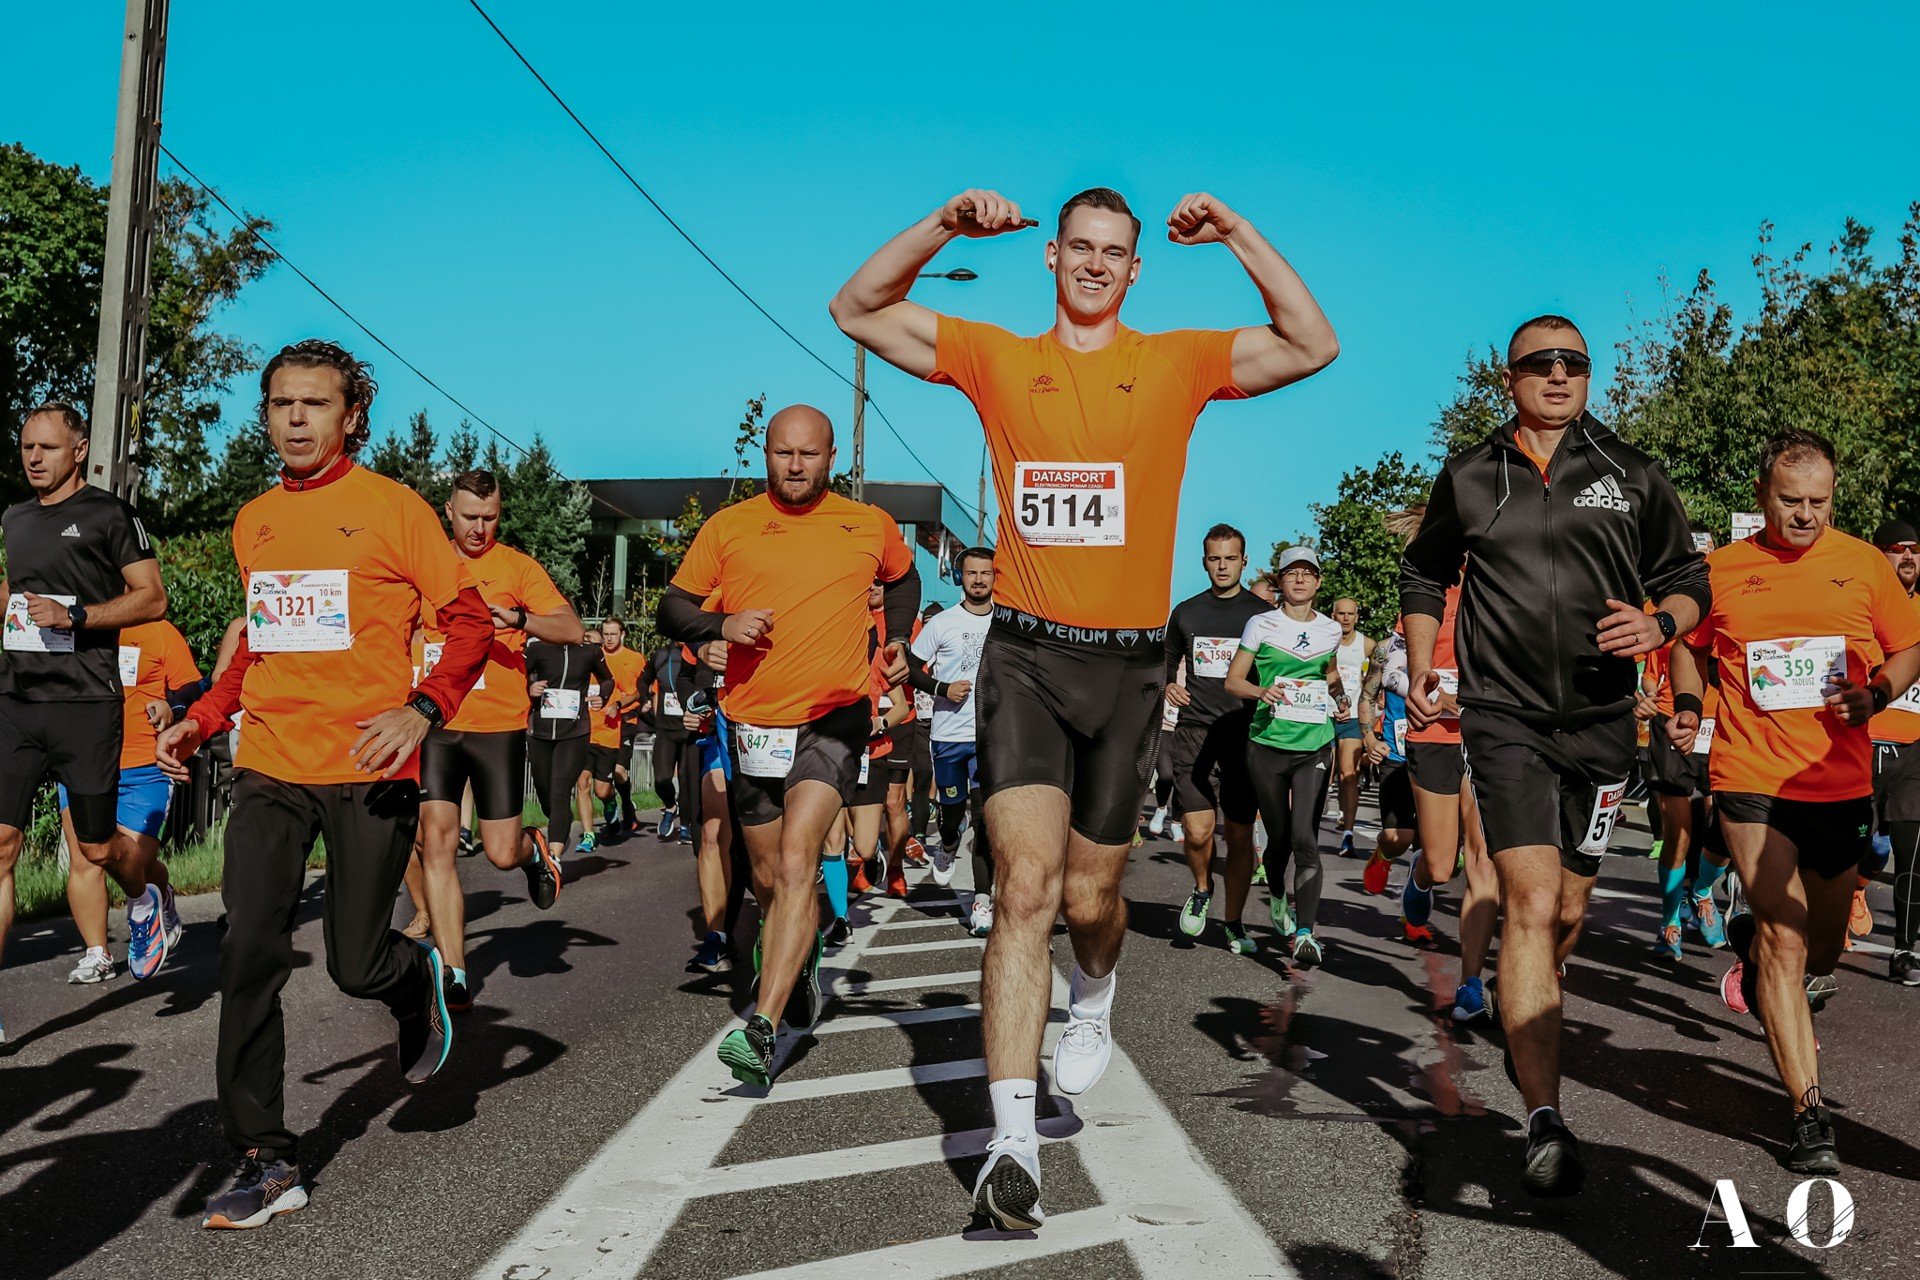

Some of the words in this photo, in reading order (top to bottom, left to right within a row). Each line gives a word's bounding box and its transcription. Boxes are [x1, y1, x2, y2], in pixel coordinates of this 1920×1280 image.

[1032, 471, 1106, 483] DATASPORT
[1573, 494, 1630, 513] adidas
[1021, 493, 1104, 527] 5114
[253, 583, 260, 595] 5
[320, 588, 329, 596] 10
[330, 588, 342, 596] km
[276, 596, 314, 616] 1321
[292, 618, 305, 626] OLEH
[1045, 621, 1108, 645] VENUM
[1210, 650, 1232, 660] 1589
[1753, 651, 1761, 661] 5
[1784, 659, 1814, 677] 359
[1792, 678, 1815, 686] TADEUSZ
[1294, 692, 1311, 703] 504
[747, 734, 769, 749] 847
